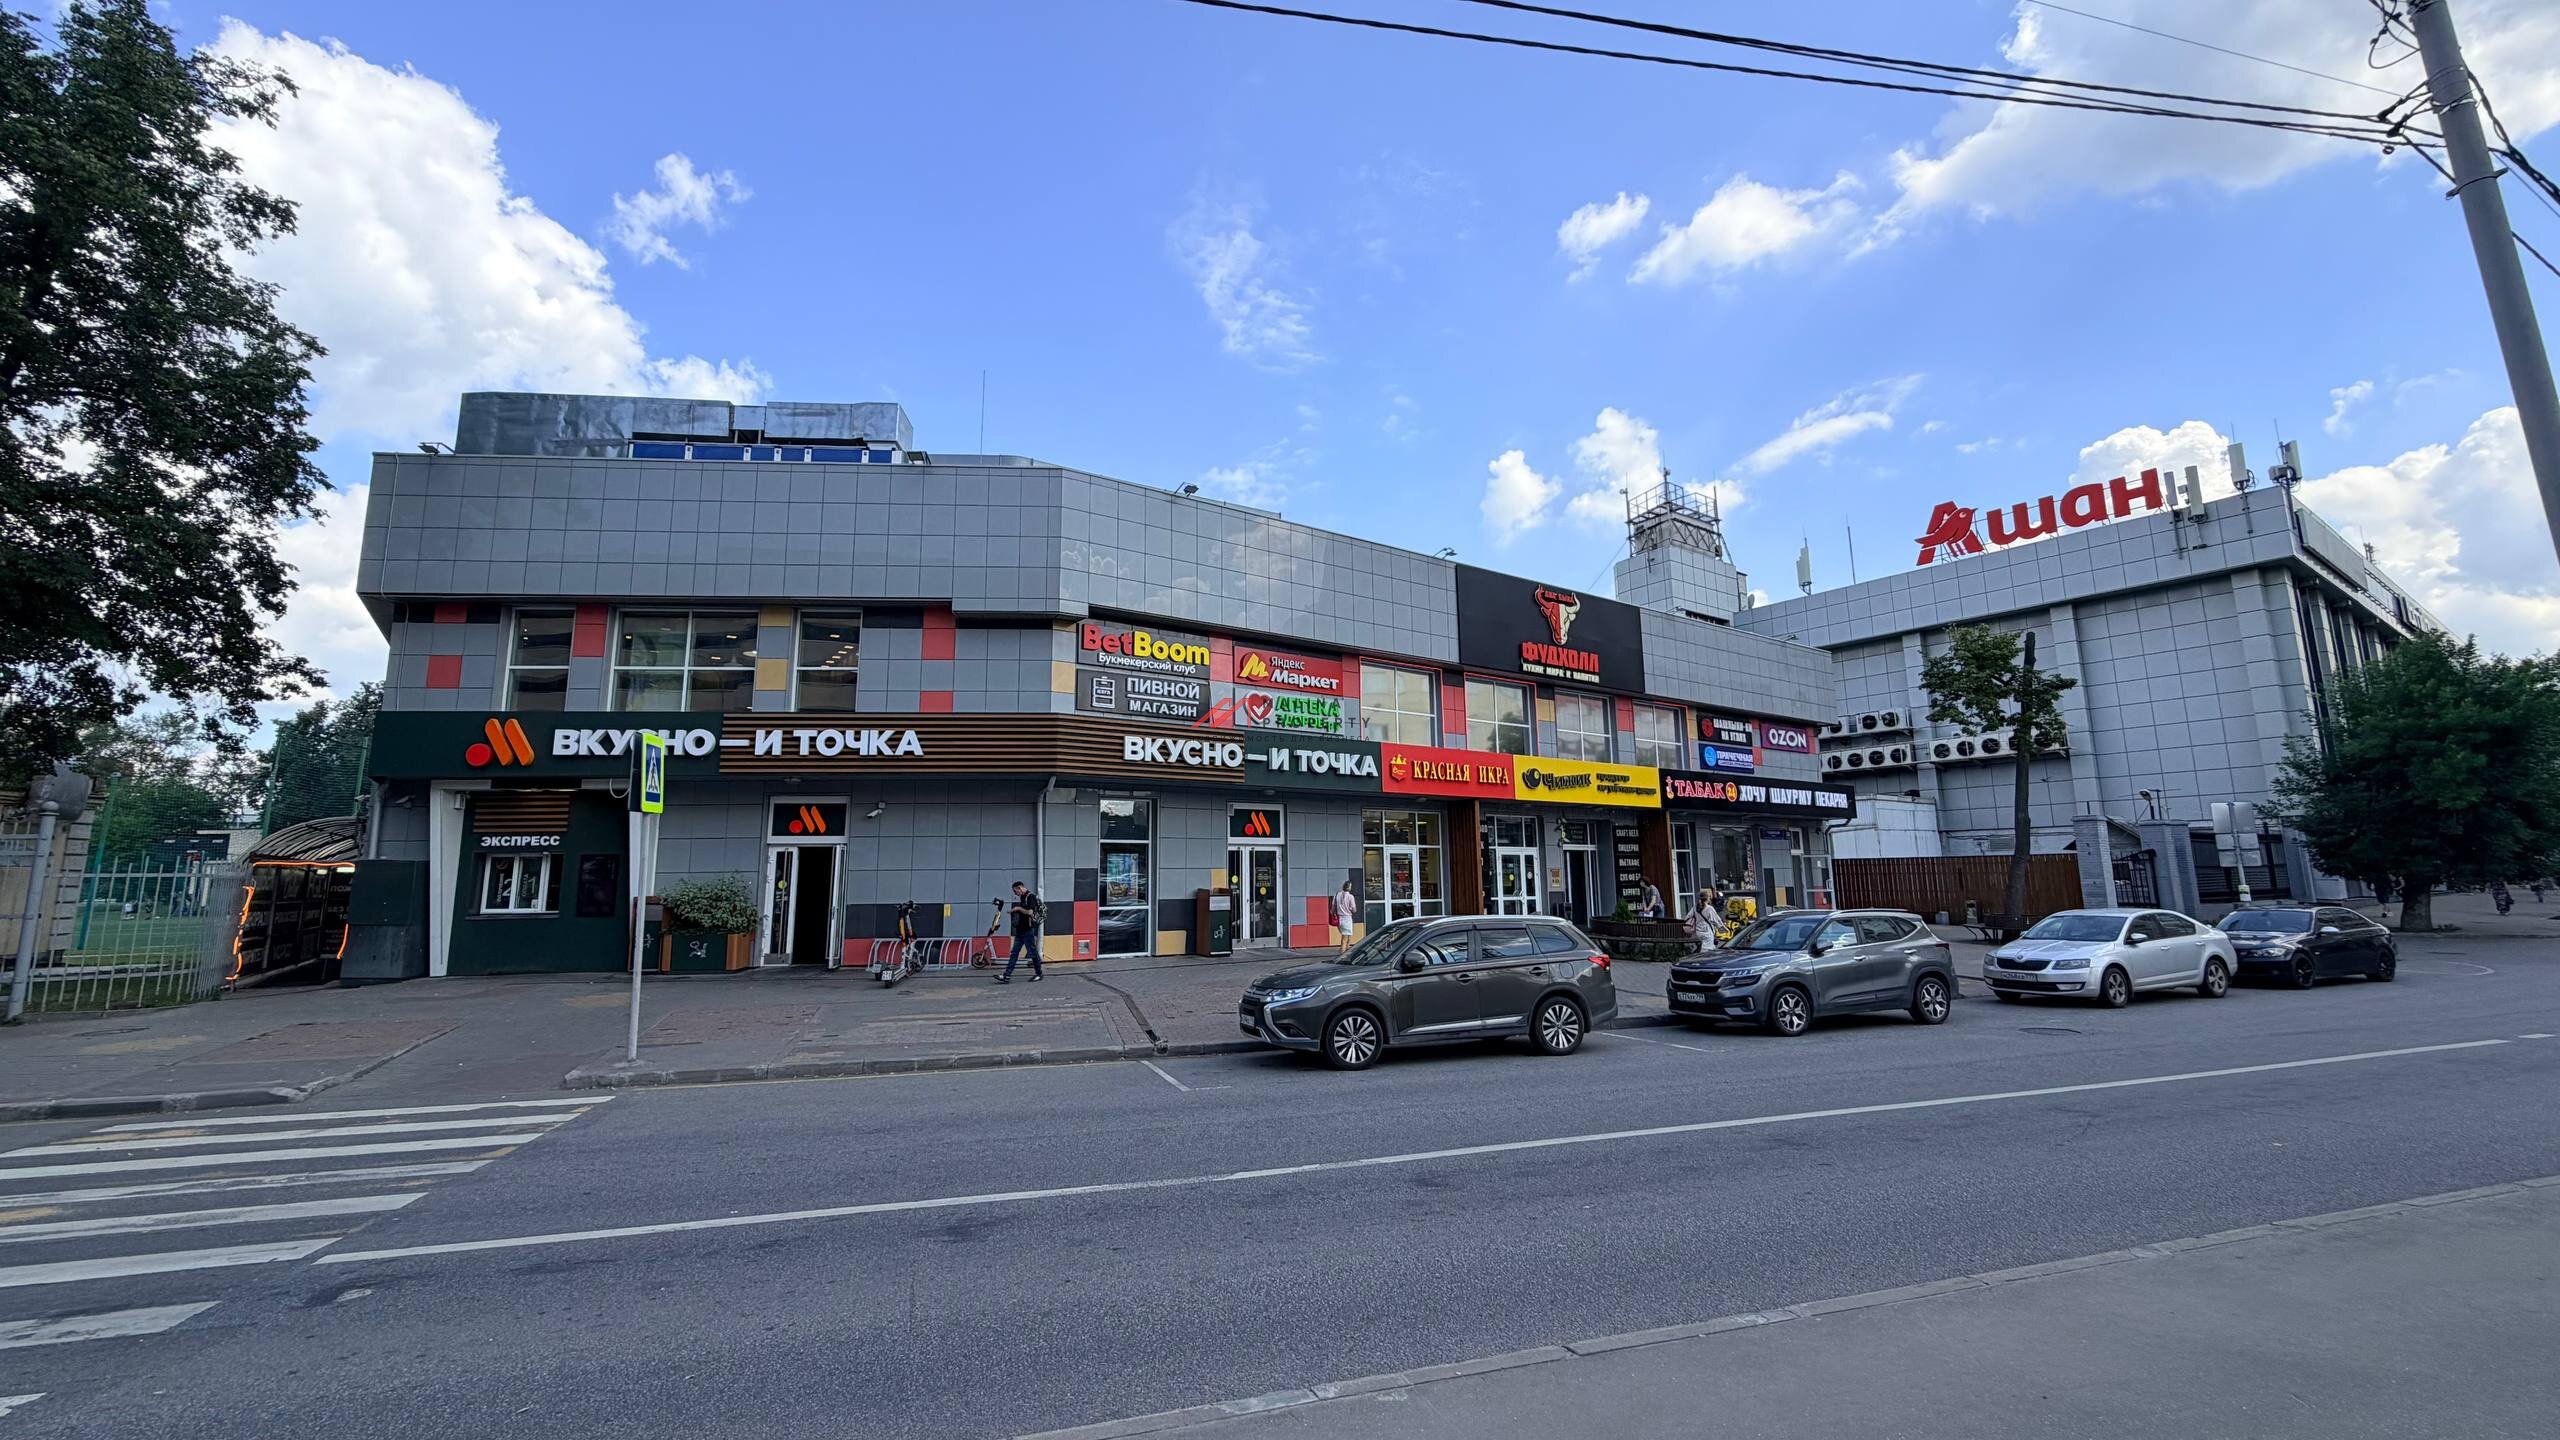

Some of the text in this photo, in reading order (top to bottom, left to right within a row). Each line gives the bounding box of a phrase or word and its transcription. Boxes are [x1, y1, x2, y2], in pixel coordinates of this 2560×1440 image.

[1915, 468, 2163, 566] Ашан
[1083, 624, 1209, 666] BetBoom
[1099, 652, 1196, 675] Букмекерский клуб
[1271, 656, 1305, 670] Яндекс
[1522, 642, 1599, 673] ФУДХОЛЛ
[1127, 677, 1200, 699] ПИВНОЙ
[1271, 669, 1339, 689] Маркет
[1128, 700, 1197, 717] МАГАЗИН
[1275, 695, 1342, 718] АПТЕКА
[552, 729, 714, 756] ВКУНО
[754, 730, 783, 755] И
[793, 729, 924, 756] ТОЧКА
[1769, 728, 1807, 747] OZON
[1123, 736, 1243, 768] ВКУСНО
[1269, 747, 1290, 771] И
[1294, 749, 1379, 777] ТОЧКА
[1716, 750, 1753, 762] ПРАЧЕЧНАЯ
[1413, 760, 1509, 784] КРАСНАЯ ИКРА
[1674, 780, 1726, 799] ТАБАК
[1738, 784, 1766, 803] ХОЧУ
[1768, 786, 1812, 806] ШАУРМУ
[480, 835, 561, 847] ЭКСПРЕСС
